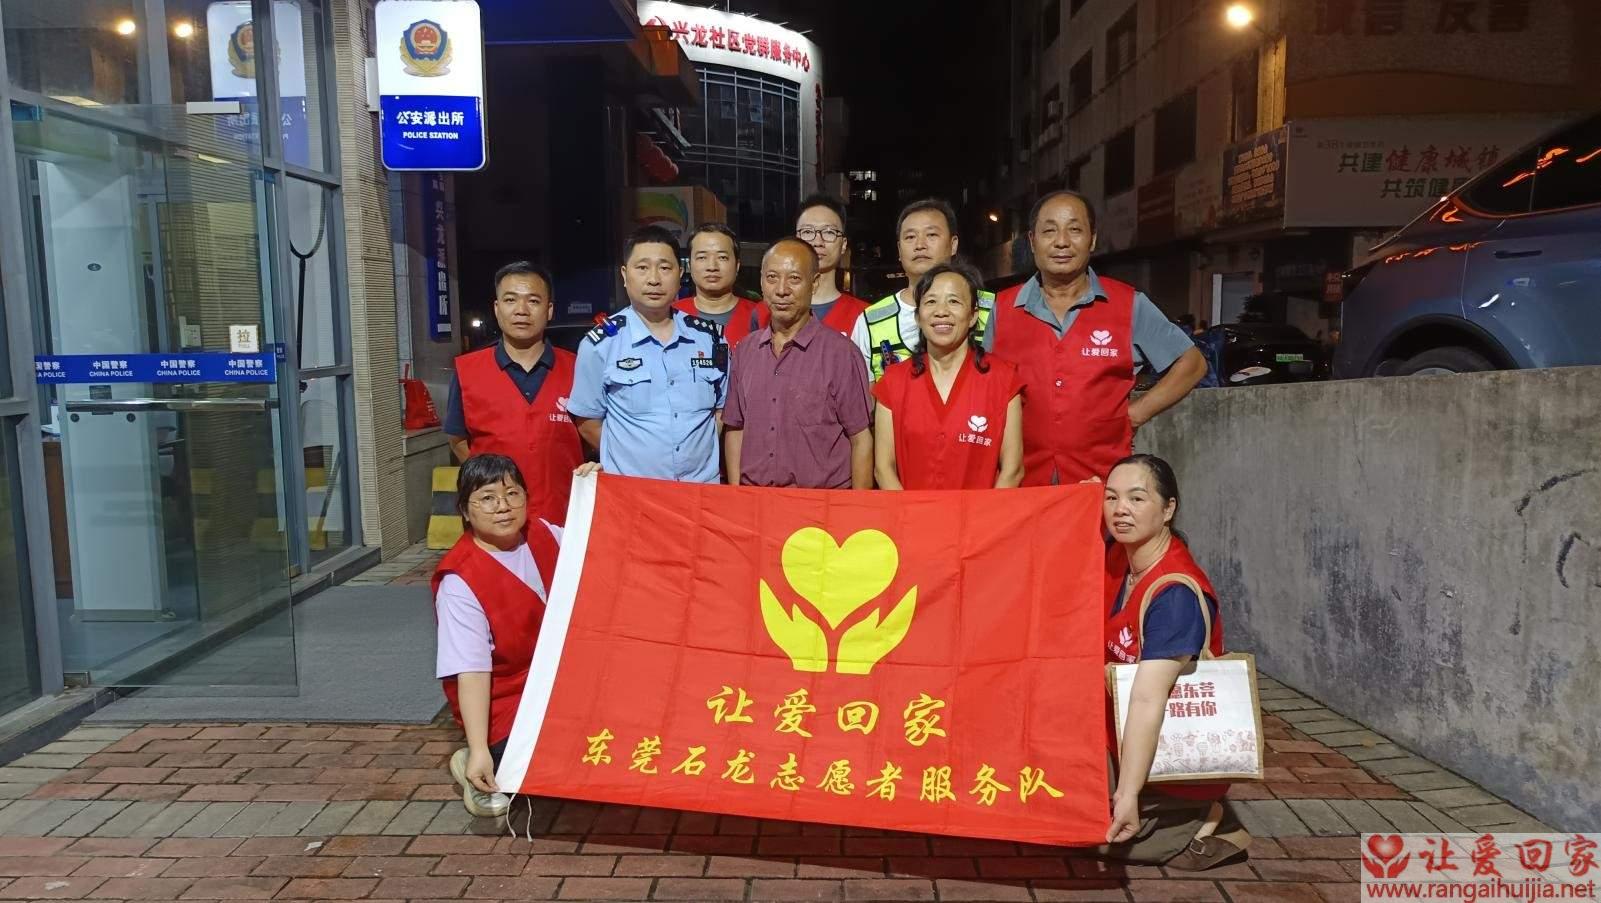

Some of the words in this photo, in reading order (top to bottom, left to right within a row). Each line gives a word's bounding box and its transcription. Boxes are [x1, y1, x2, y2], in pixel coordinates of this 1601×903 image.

[671, 20, 810, 72] 兴龙社区党群服务中心
[396, 110, 465, 126] 公安派出所
[403, 131, 427, 139] POLICE
[237, 328, 251, 343] 拉
[1081, 346, 1119, 358] 让爱回家
[93, 360, 128, 370] 中国警察
[160, 359, 196, 369] 中国警察
[228, 359, 263, 369] 中国警察
[156, 369, 177, 377] CHINA
[958, 432, 993, 447] 让爱回家
[1107, 639, 1137, 664] 让爱回家
[707, 686, 948, 747] 让爱回家
[581, 728, 1065, 806] 东莞石龙志愿者服务队
